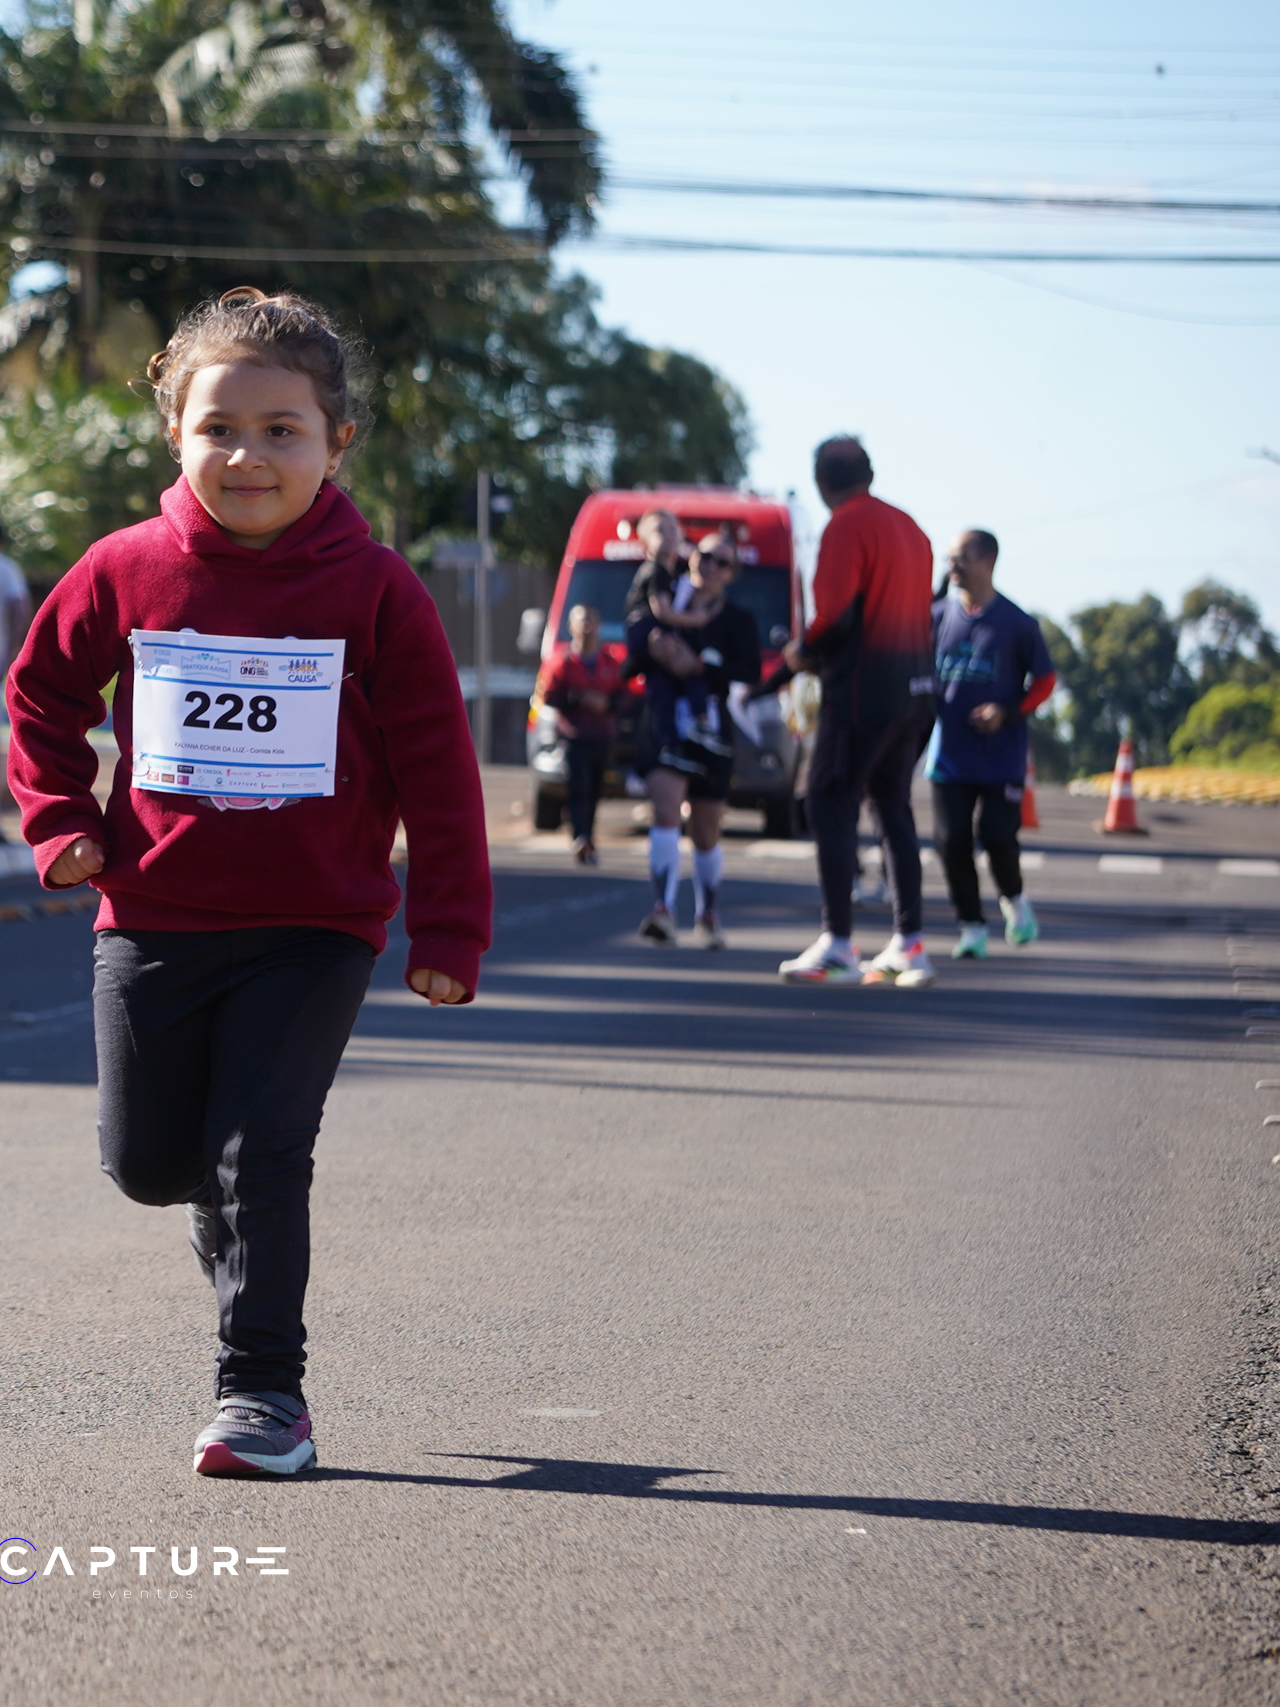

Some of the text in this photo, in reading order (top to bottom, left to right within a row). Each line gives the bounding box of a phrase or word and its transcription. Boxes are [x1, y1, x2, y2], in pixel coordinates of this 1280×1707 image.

[182, 663, 228, 673] PRATIQUE AJUDA
[288, 674, 317, 683] CAUSA
[182, 690, 277, 733] 228
[199, 743, 221, 752] ECHER
